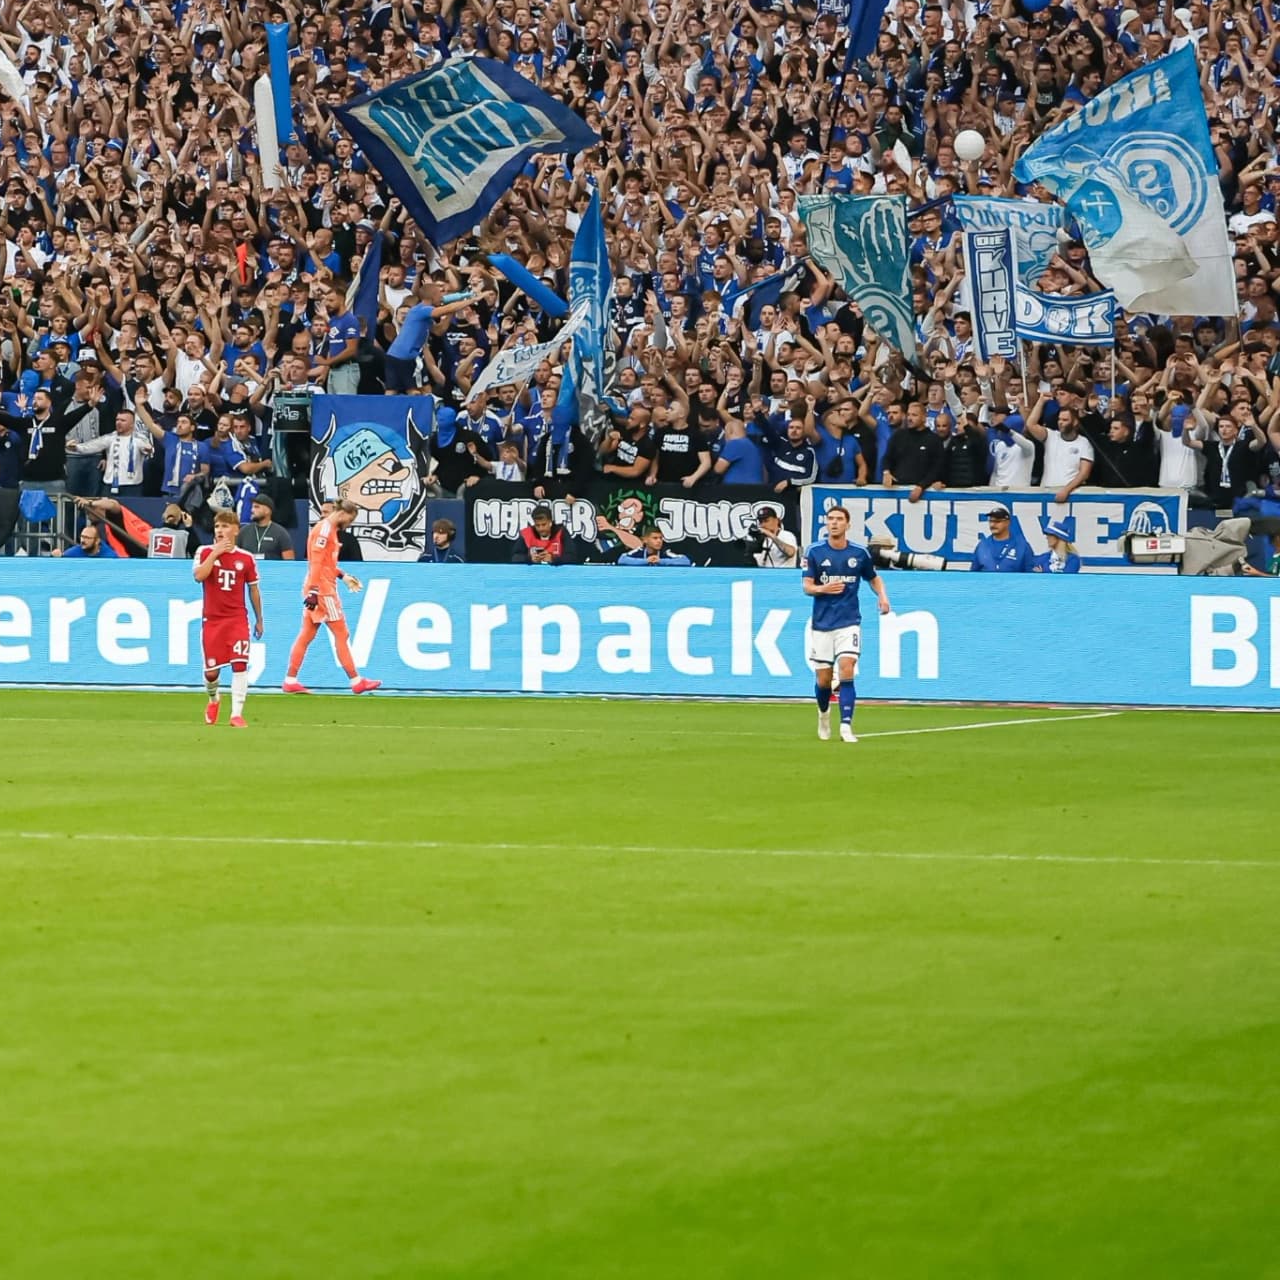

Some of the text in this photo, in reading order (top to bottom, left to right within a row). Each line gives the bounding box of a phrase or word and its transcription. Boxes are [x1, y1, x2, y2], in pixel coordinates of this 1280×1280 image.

[975, 234, 1006, 247] DIE
[977, 250, 1015, 358] KURVE
[233, 640, 250, 656] 42
[852, 634, 859, 648] 8
